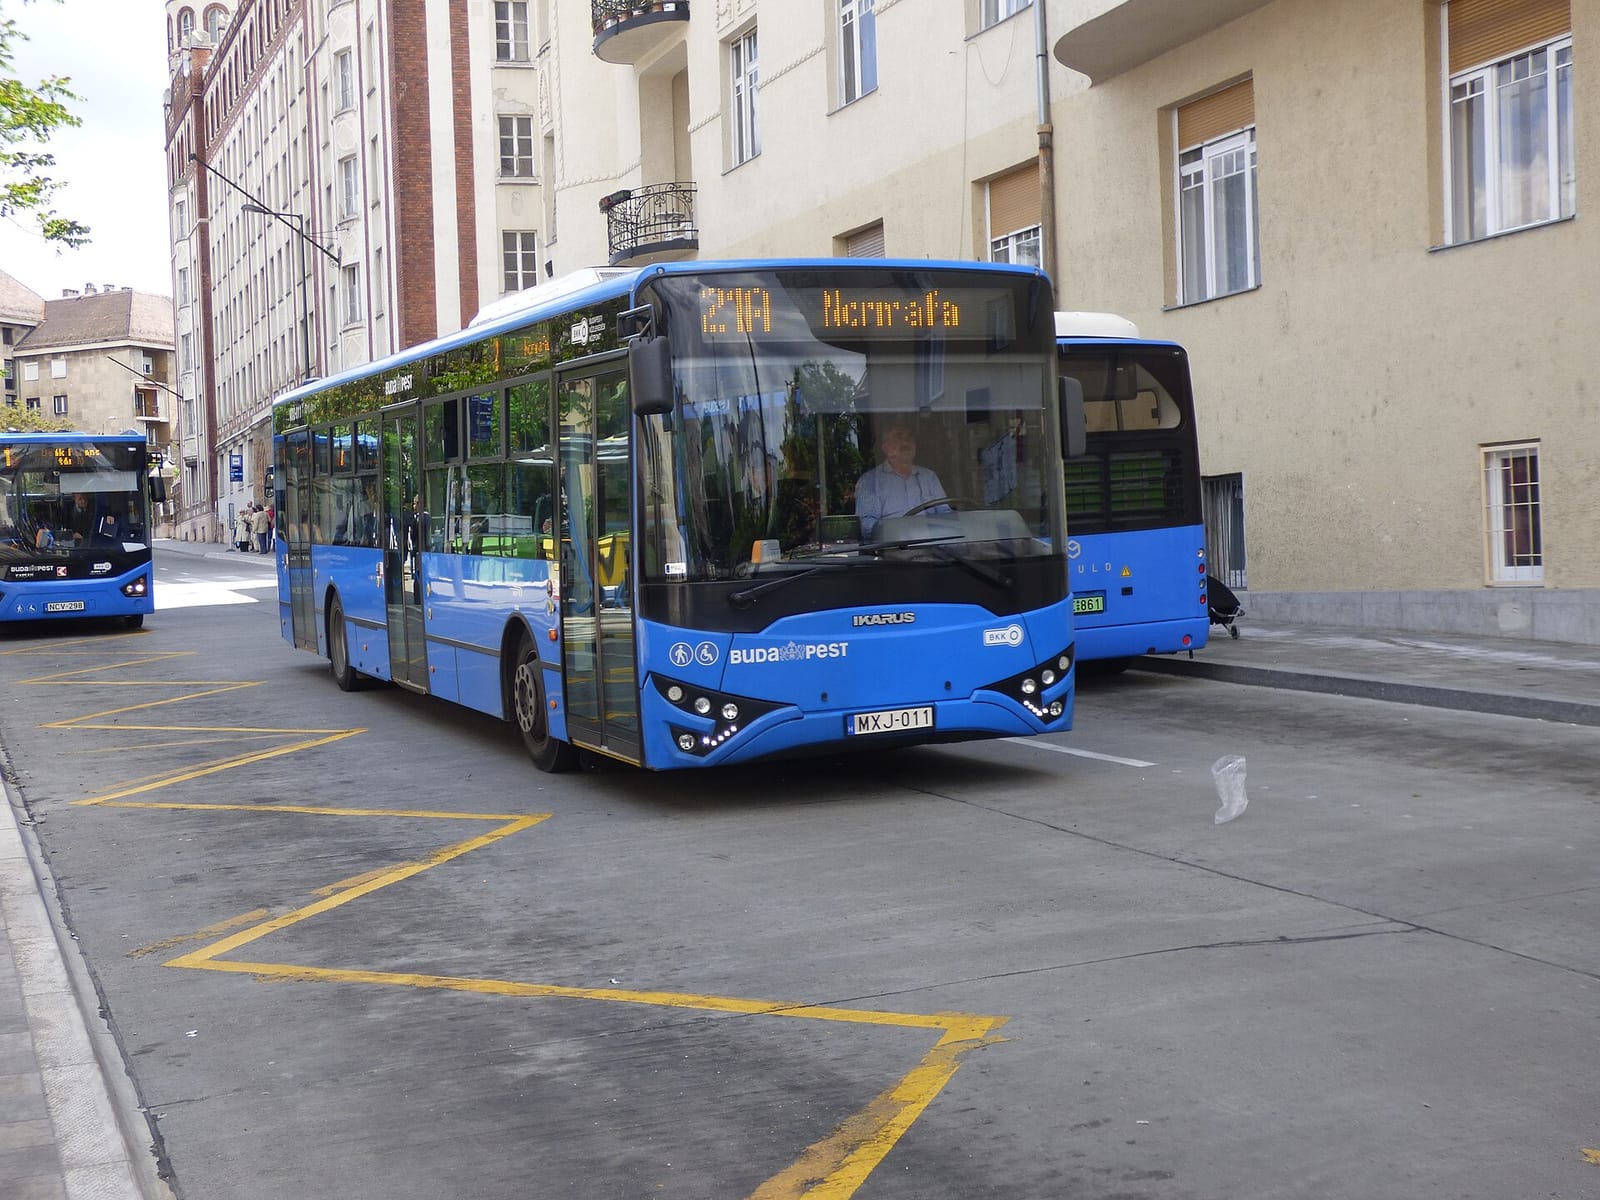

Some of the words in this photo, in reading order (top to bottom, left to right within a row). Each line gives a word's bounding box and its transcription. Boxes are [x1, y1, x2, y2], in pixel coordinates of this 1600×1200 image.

[701, 287, 771, 333] 21A
[1078, 562, 1111, 574] ULO
[853, 612, 916, 627] IKARUS
[989, 632, 1006, 641] BKK
[858, 709, 929, 732] MXJ-011
